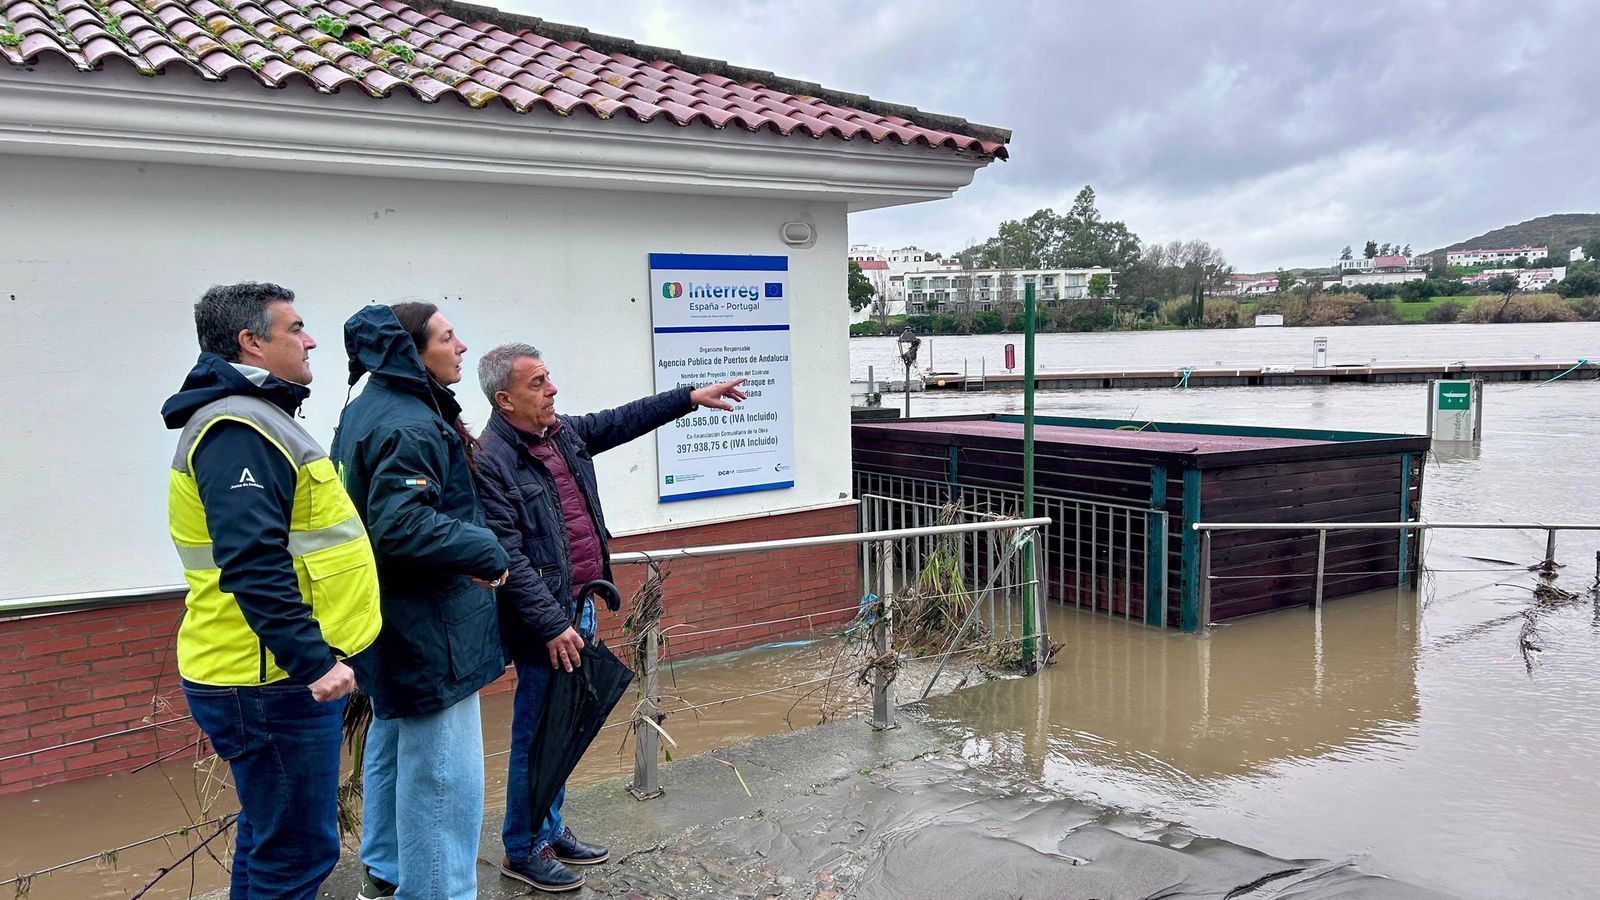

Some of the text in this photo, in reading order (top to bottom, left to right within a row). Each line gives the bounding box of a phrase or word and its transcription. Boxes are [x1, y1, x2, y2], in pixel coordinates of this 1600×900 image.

[688, 282, 758, 300] Interreg
[690, 302, 719, 312] España
[727, 302, 760, 312] Portugal
[658, 358, 685, 369] Agencia
[688, 357, 712, 366] Pública
[714, 356, 721, 365] de
[723, 355, 748, 364] Puertos
[676, 411, 778, 428] 530.585,00 € (IVA Incluido)
[677, 436, 778, 454] 397.938,75 € (IVA Incluido)
